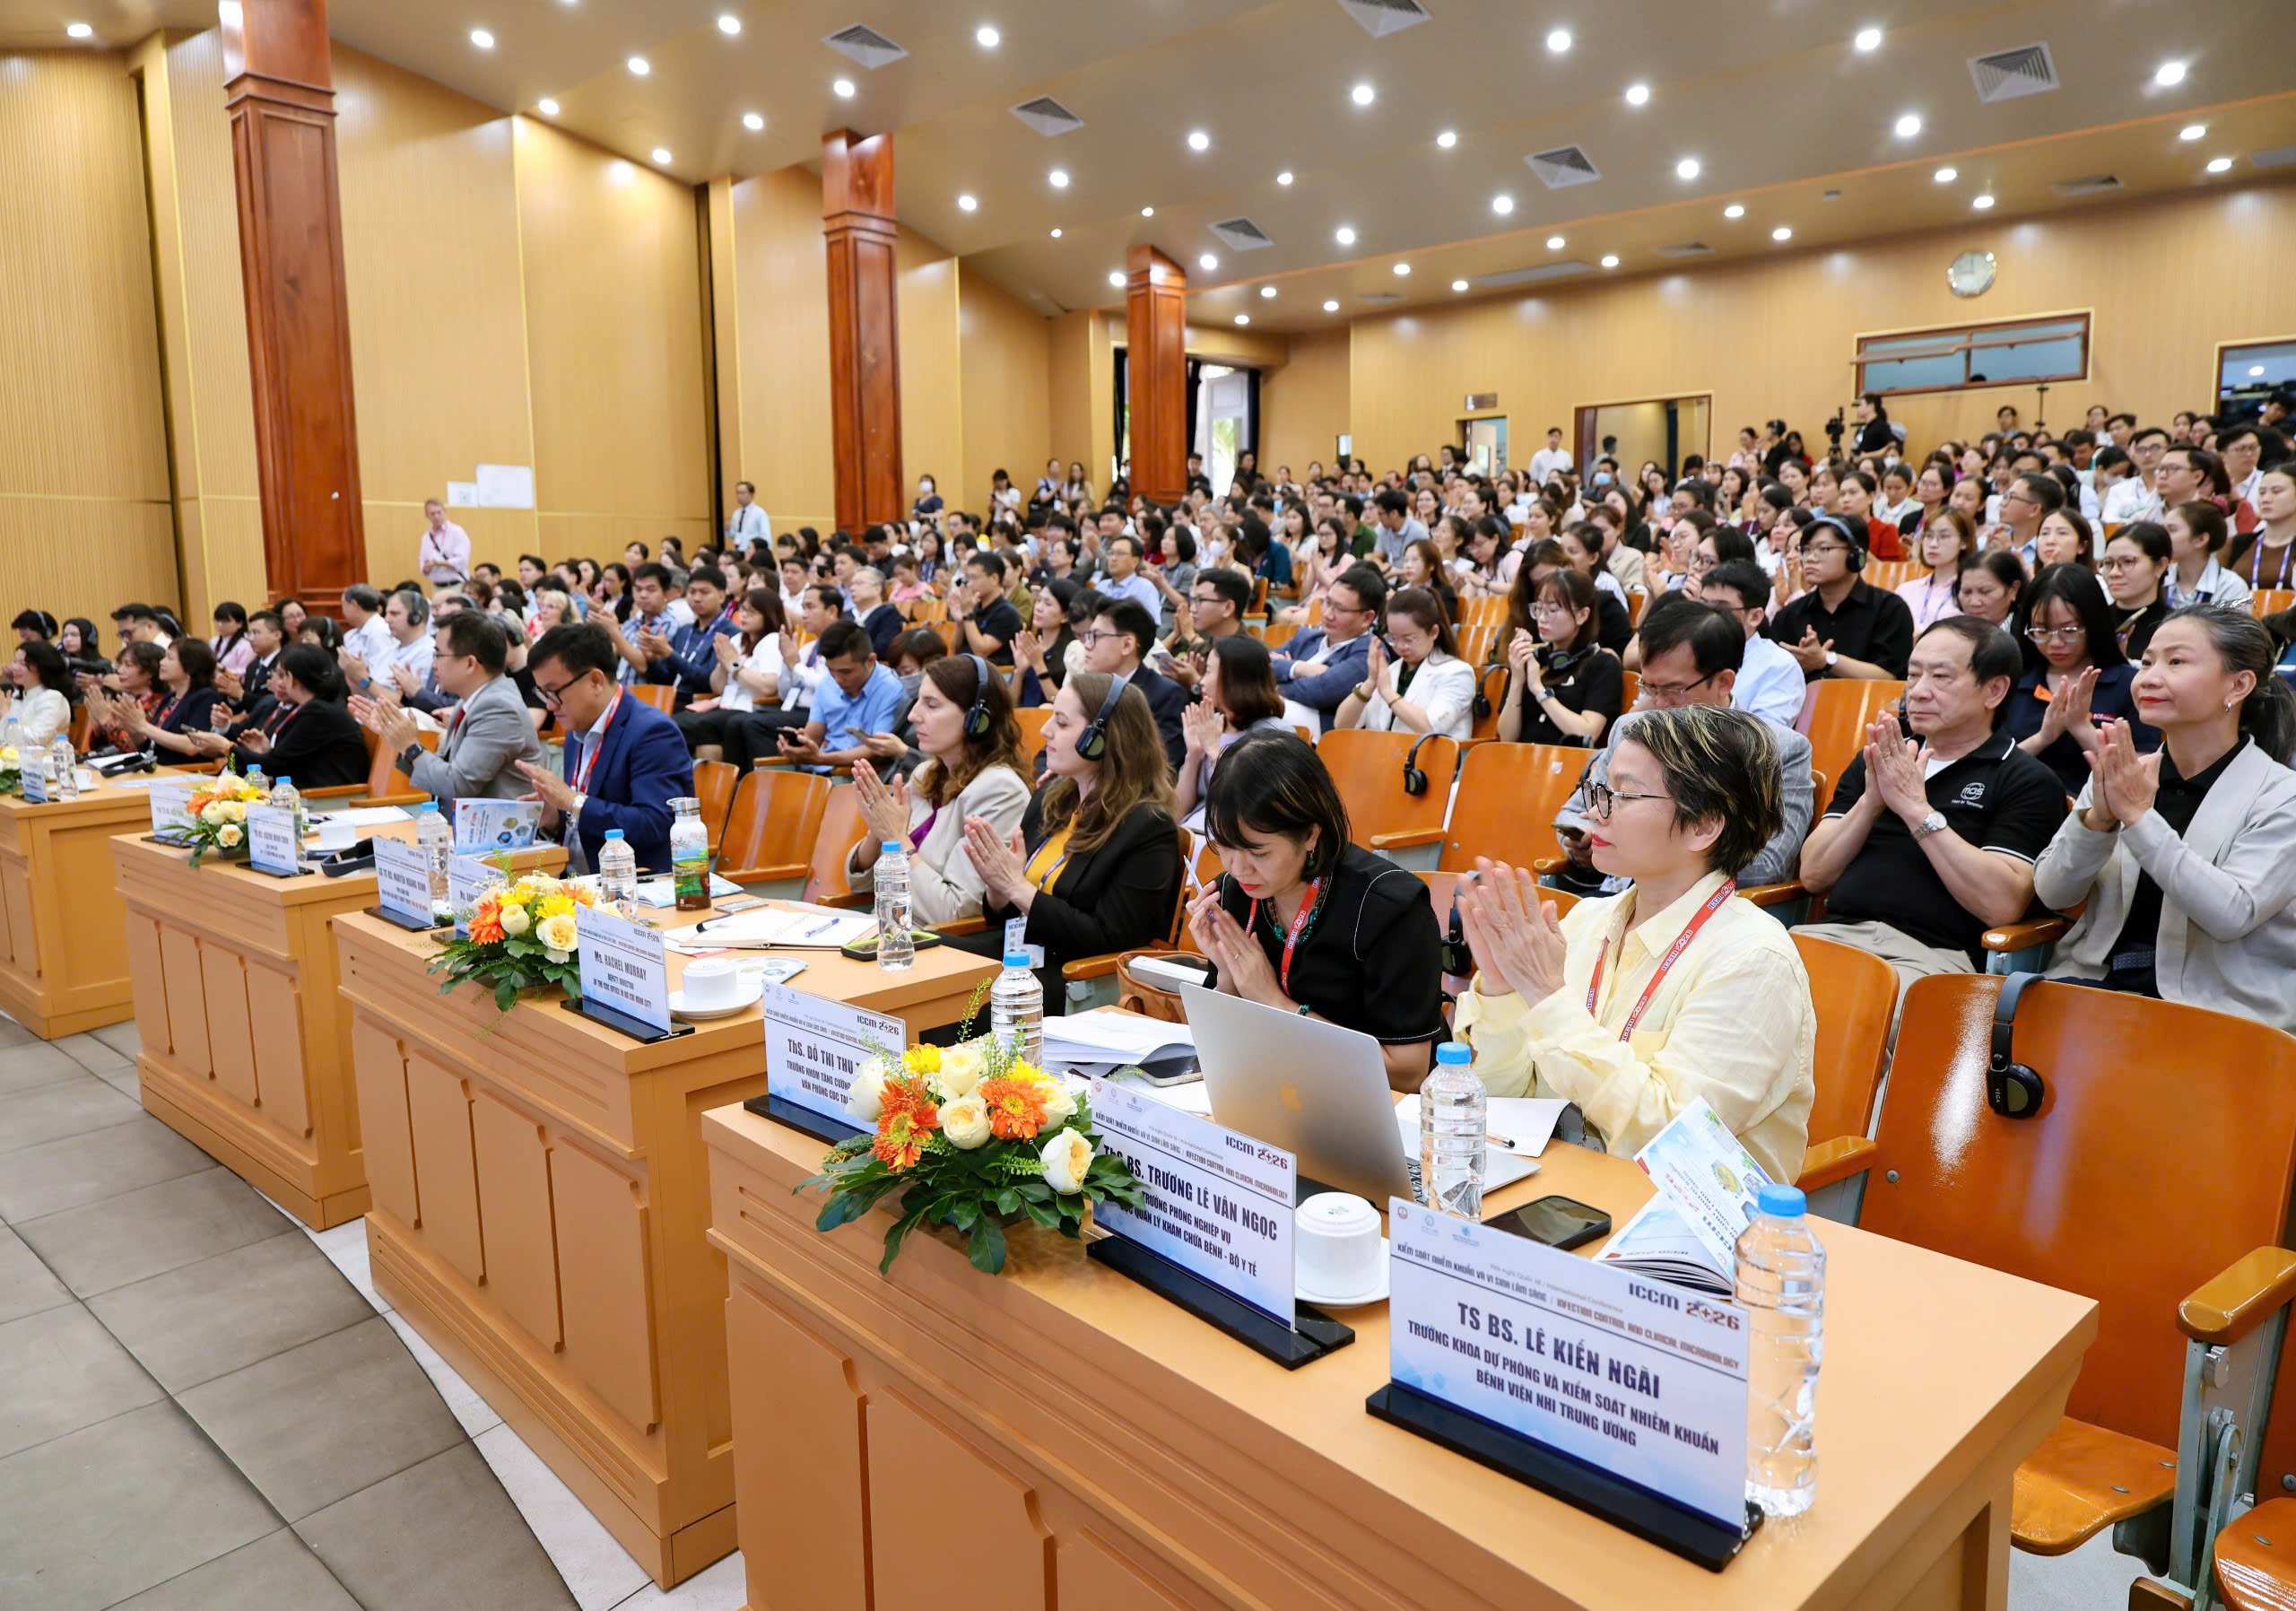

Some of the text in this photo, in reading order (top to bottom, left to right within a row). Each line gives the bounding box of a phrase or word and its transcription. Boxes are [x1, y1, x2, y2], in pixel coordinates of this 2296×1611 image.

[604, 954, 623, 971] RACHEL
[625, 962, 647, 980] MURRAY
[787, 1039, 804, 1058] ThS.
[837, 1056, 853, 1075] THU
[1226, 1136, 1254, 1155] ICCM
[1127, 1155, 1144, 1180] BS.
[1148, 1164, 1192, 1202] TRƯƠNG
[1197, 1187, 1209, 1209] LÊ
[1213, 1194, 1237, 1223] VÂN
[1242, 1207, 1276, 1241] NGỌC
[1222, 1229, 1231, 1246] VỤ
[1205, 1240, 1222, 1259] BỆNH
[1230, 1252, 1239, 1270] BỘ
[1241, 1258, 1246, 1271] Y
[1248, 1260, 1257, 1277] TẾ
[1629, 1283, 1679, 1311] ICCM
[1458, 1302, 1659, 1398] TS BS. LÊ KIẾN NGÃI
[1452, 1337, 1480, 1361] KHOA
[1484, 1348, 1500, 1370] DỰ
[1502, 1356, 1540, 1383] PHÒNG
[1544, 1372, 1559, 1391] VÀ
[1596, 1392, 1626, 1417] SOÁT
[1477, 1369, 1636, 1447] BỆNH VIỆN NHI TRUNG ƯƠNG
